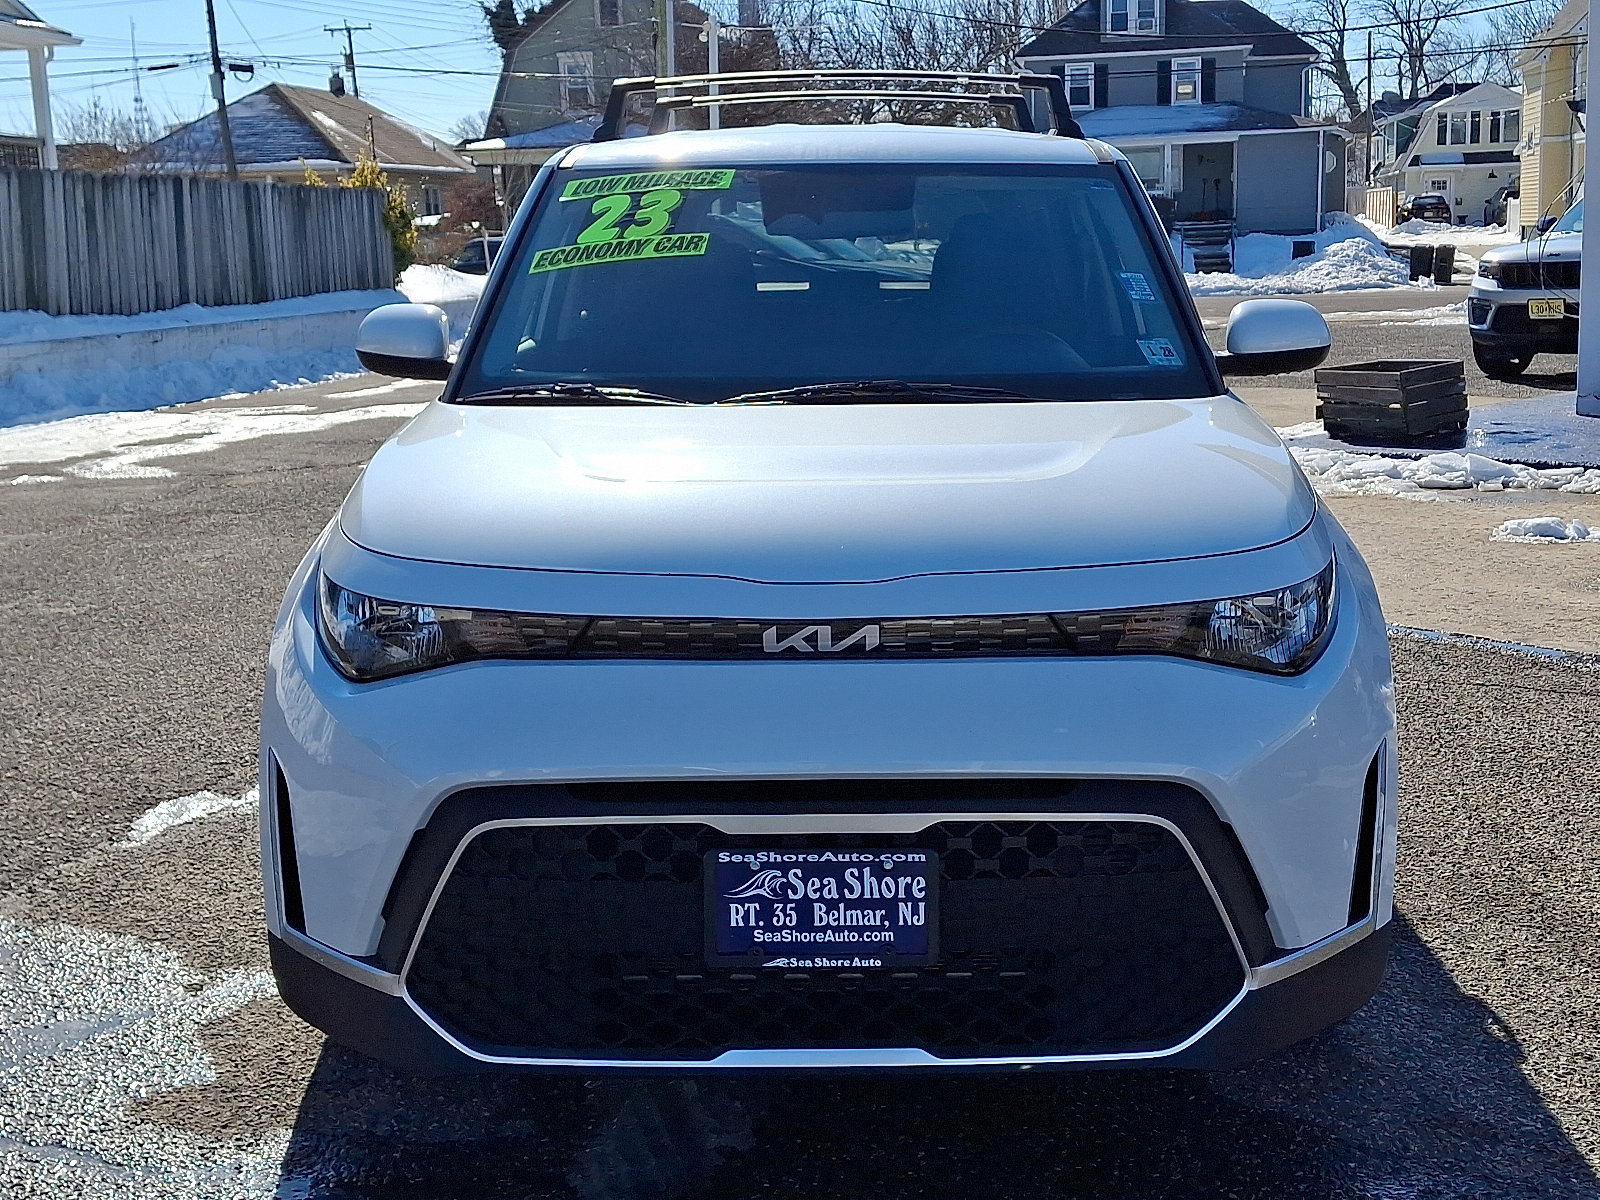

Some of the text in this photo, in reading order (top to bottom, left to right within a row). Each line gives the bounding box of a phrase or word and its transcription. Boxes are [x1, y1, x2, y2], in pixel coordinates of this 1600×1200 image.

[571, 170, 728, 197] LOW MILEAGE
[576, 189, 683, 244] 23
[533, 235, 707, 270] ECONOMY CAR
[762, 624, 880, 652] KIA
[718, 851, 927, 863] SeaShoreAuto.com
[787, 866, 926, 899] Sea Shore
[729, 902, 926, 929] RT. 35 Belmar, NJ
[753, 929, 894, 943] SeaShoreAuto.com
[789, 957, 882, 968] Sea Shore Auto
